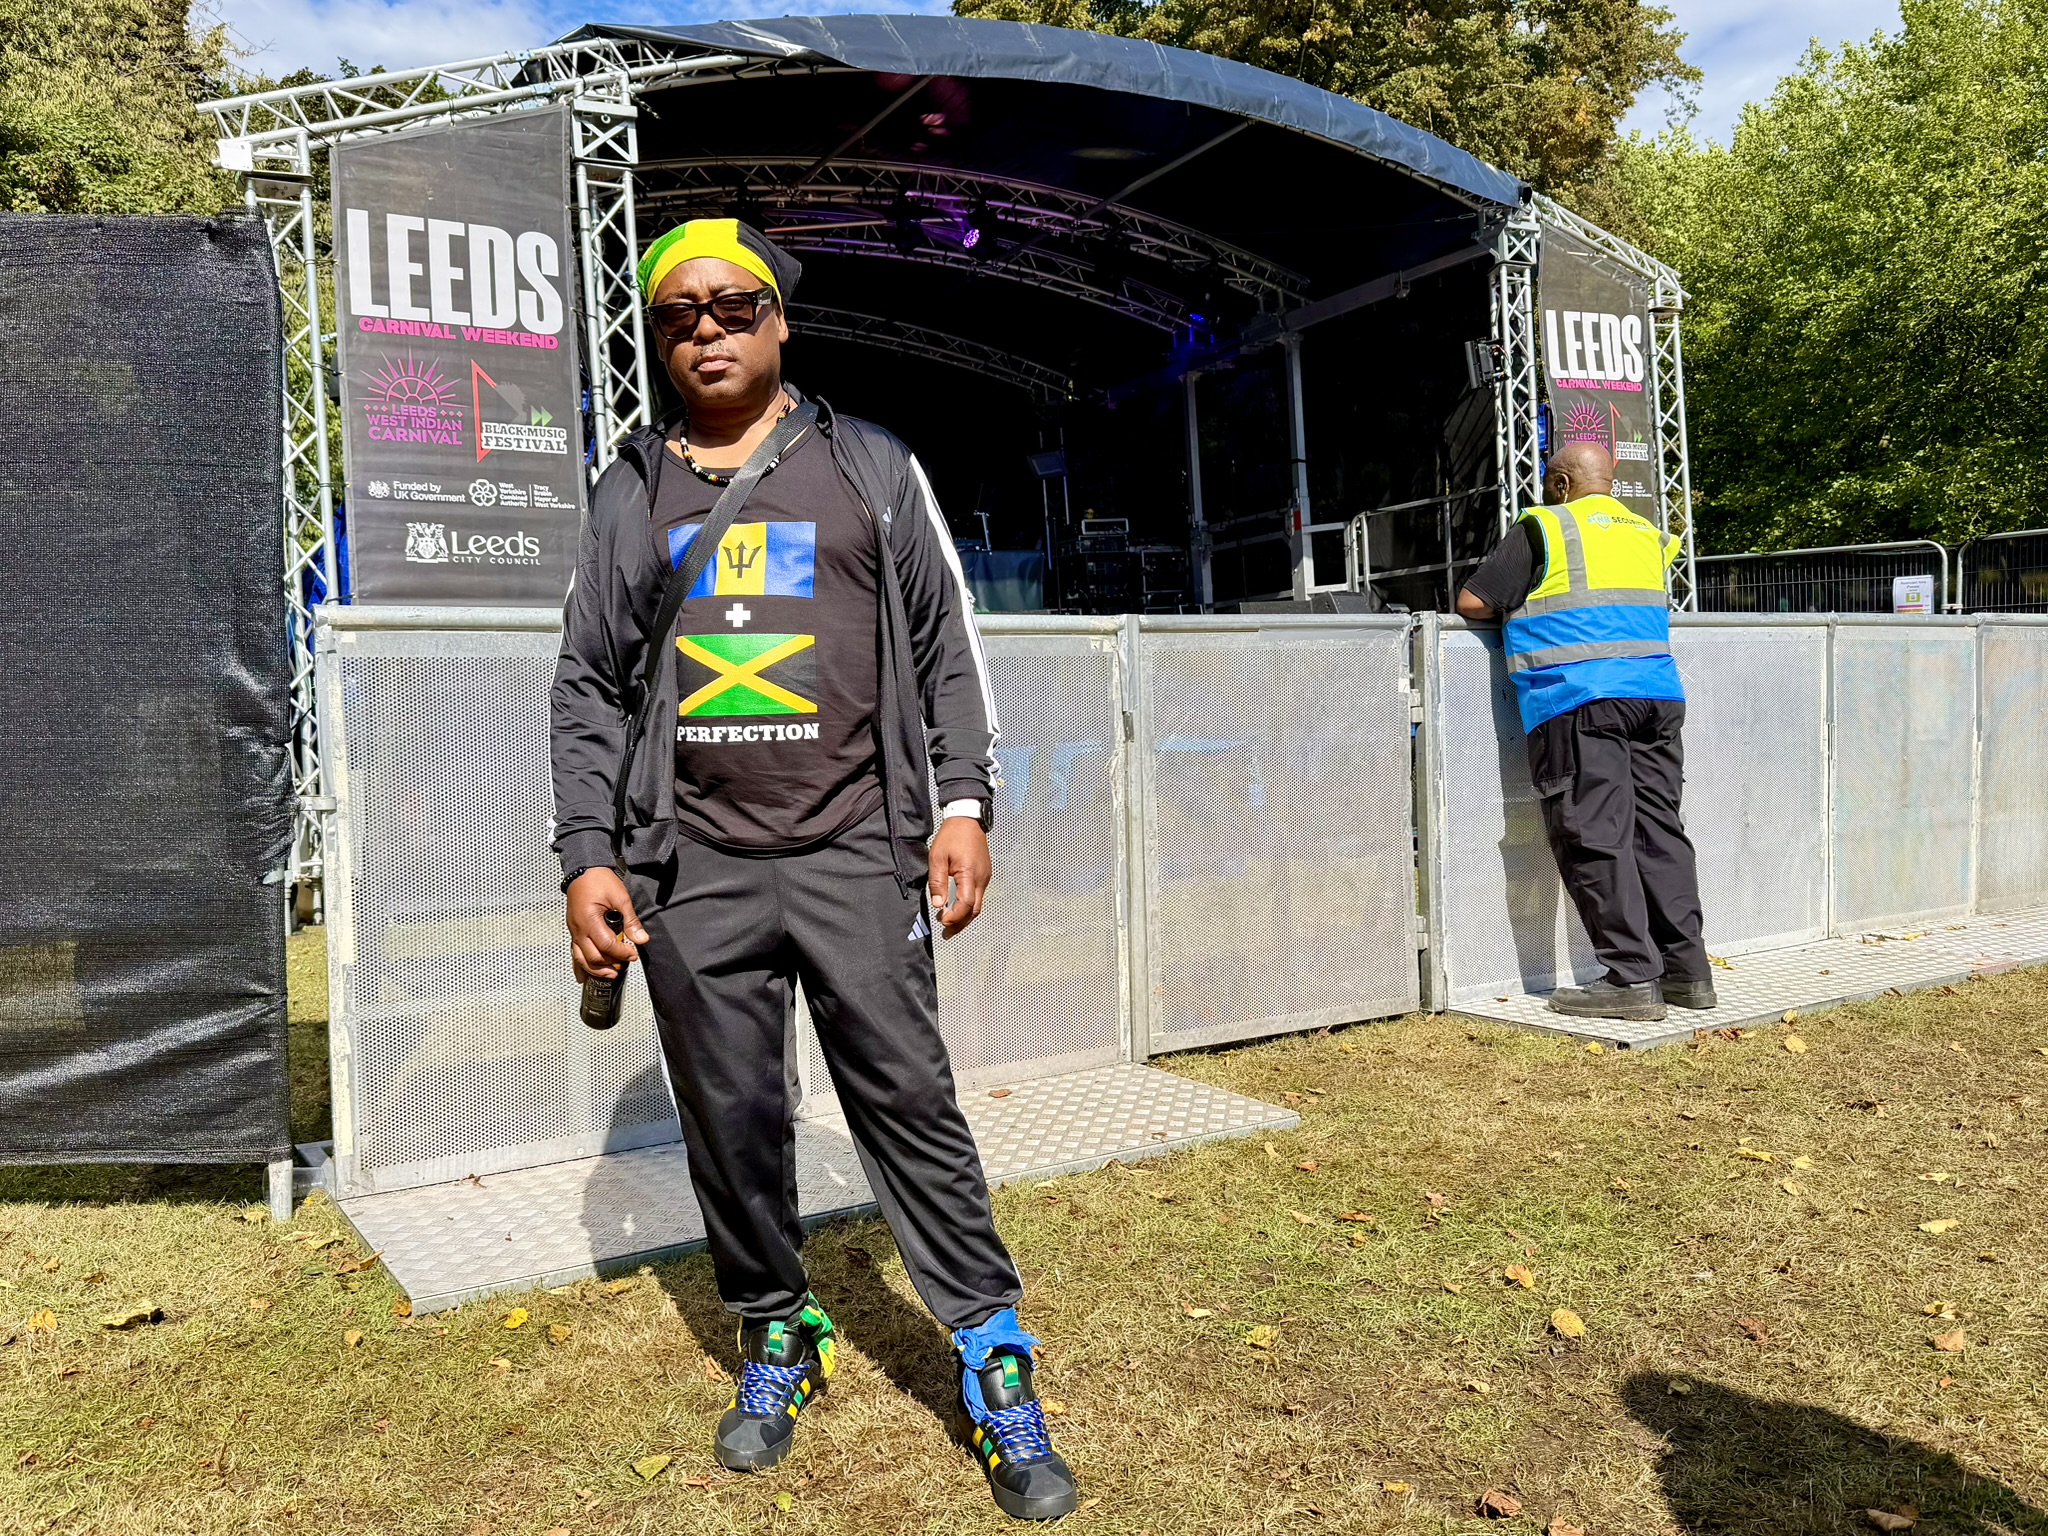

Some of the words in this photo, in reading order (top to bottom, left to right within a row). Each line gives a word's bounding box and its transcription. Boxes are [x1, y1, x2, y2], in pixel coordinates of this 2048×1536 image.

[347, 208, 564, 335] LEEDS
[358, 317, 456, 340] CARNIVAL
[461, 326, 560, 350] WEEKEND
[1545, 309, 1644, 383] LEEDS
[1556, 378, 1601, 389] CARNIVAL
[1602, 380, 1643, 392] WEEKEND
[391, 403, 437, 418] LEEDS
[365, 413, 407, 427] WEST
[411, 417, 463, 431] INDIAN
[368, 426, 463, 446] CARNIVAL
[484, 424, 524, 434] BLACK
[527, 428, 565, 439] MUSIC
[1575, 432, 1597, 441] LEEDS
[483, 435, 565, 452] FESTIVAL
[393, 480, 428, 491] Funded
[429, 482, 441, 493] by
[393, 490, 409, 500] UK
[410, 491, 466, 503] Government
[451, 531, 541, 557] Leeds
[452, 556, 482, 564] CITY
[489, 557, 541, 566] COUNCIL
[676, 723, 820, 743] PERFECTION
